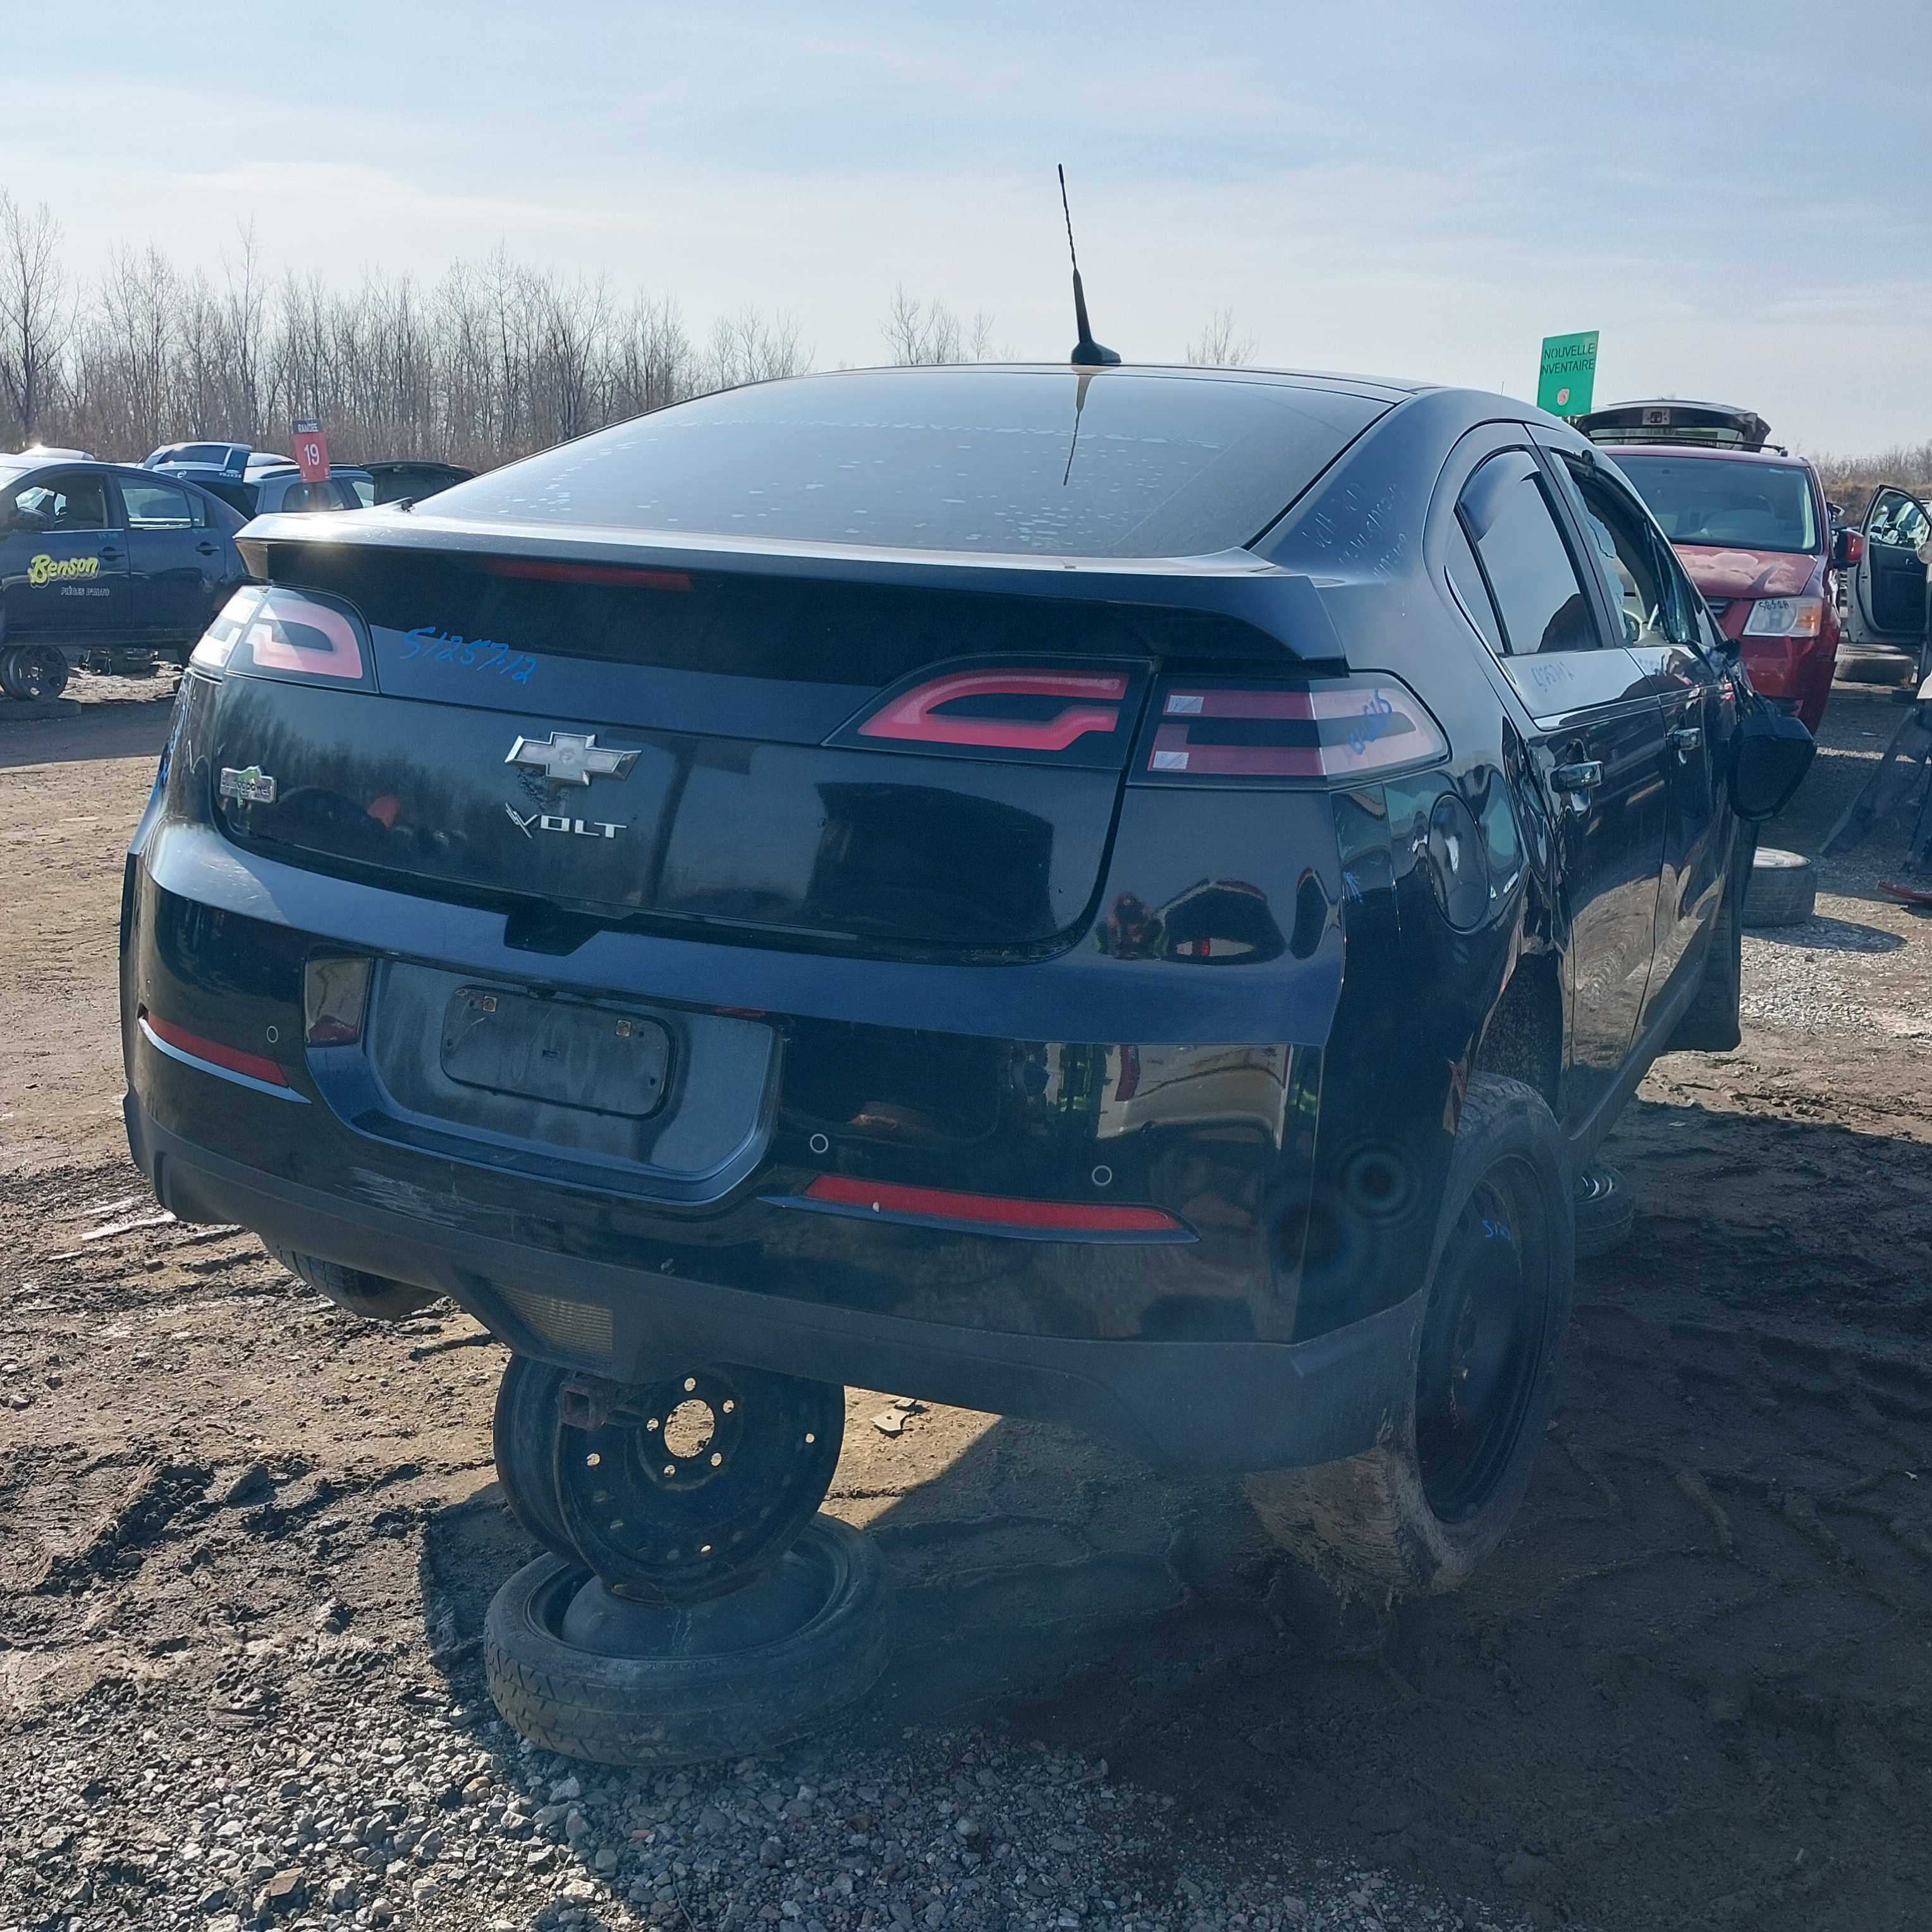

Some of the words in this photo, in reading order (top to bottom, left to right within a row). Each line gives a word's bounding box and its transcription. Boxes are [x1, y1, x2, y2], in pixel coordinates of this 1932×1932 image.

[1544, 343, 1594, 359] NOUVELLE
[303, 444, 320, 466] 19
[27, 553, 101, 589] Benson
[504, 801, 628, 840] VOLT
